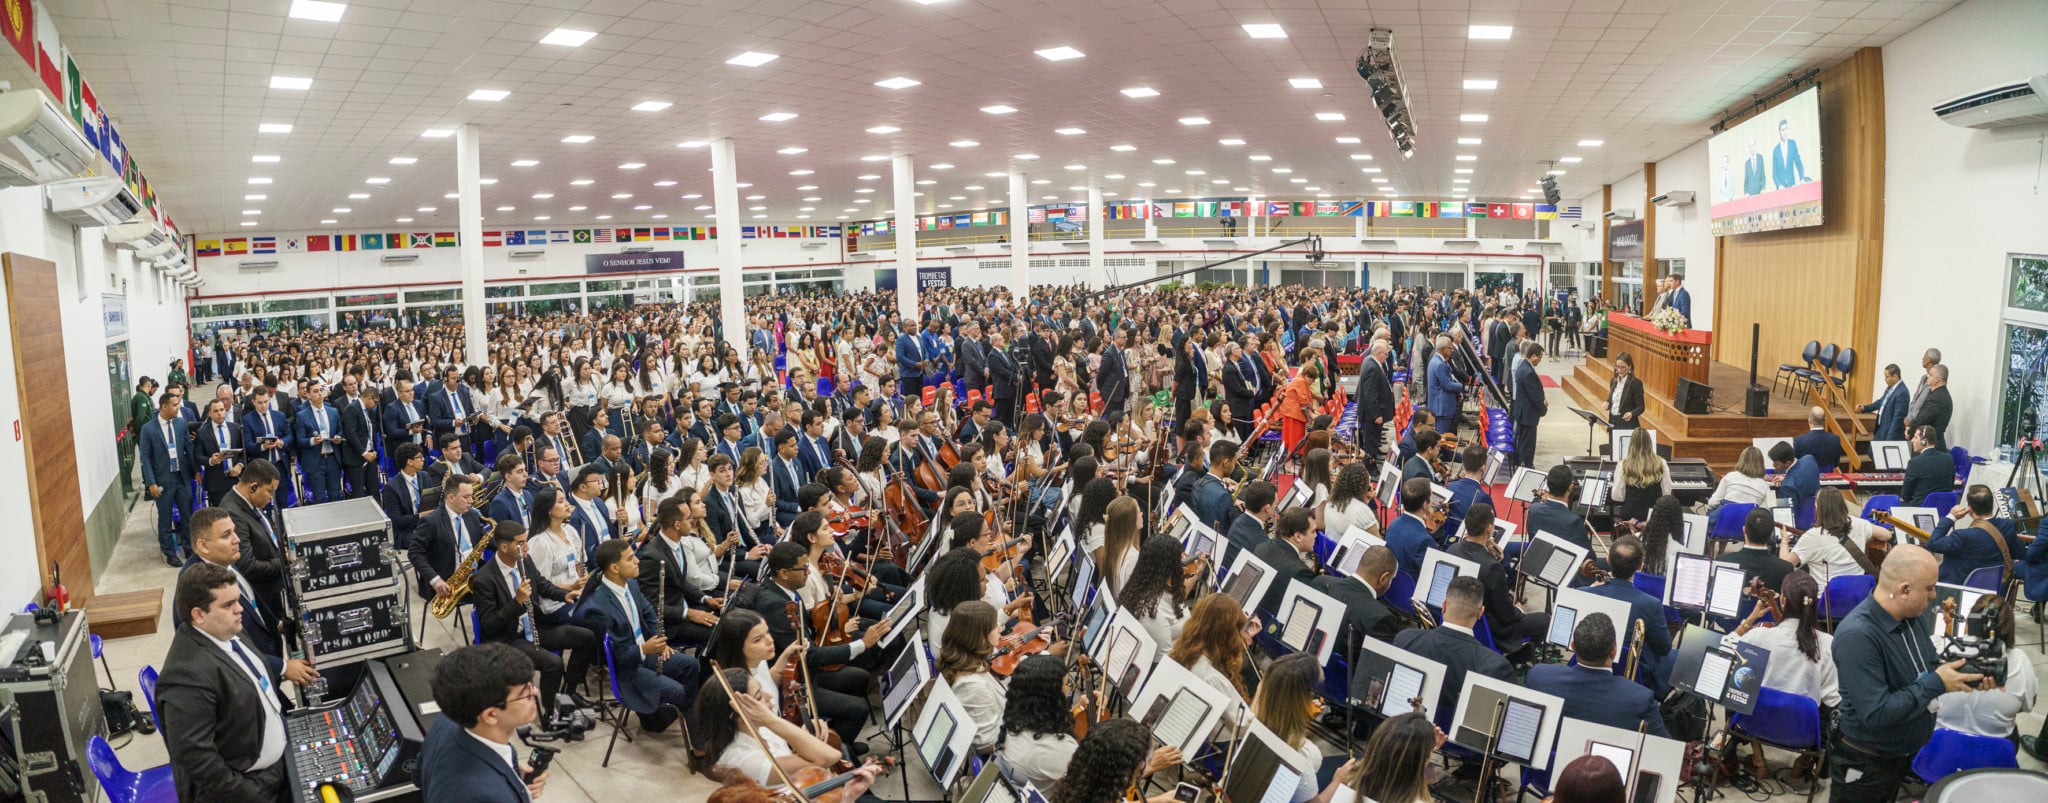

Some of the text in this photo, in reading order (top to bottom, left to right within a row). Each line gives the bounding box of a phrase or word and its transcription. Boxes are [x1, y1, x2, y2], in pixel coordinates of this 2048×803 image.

[609, 259, 635, 267] SENHOR
[919, 271, 947, 280] TROMBETAS
[927, 280, 947, 288] FESTAS
[362, 535, 379, 547] 02
[309, 567, 376, 588] PSM 1000
[376, 599, 391, 610] 01
[323, 629, 389, 651] PSM 1000
